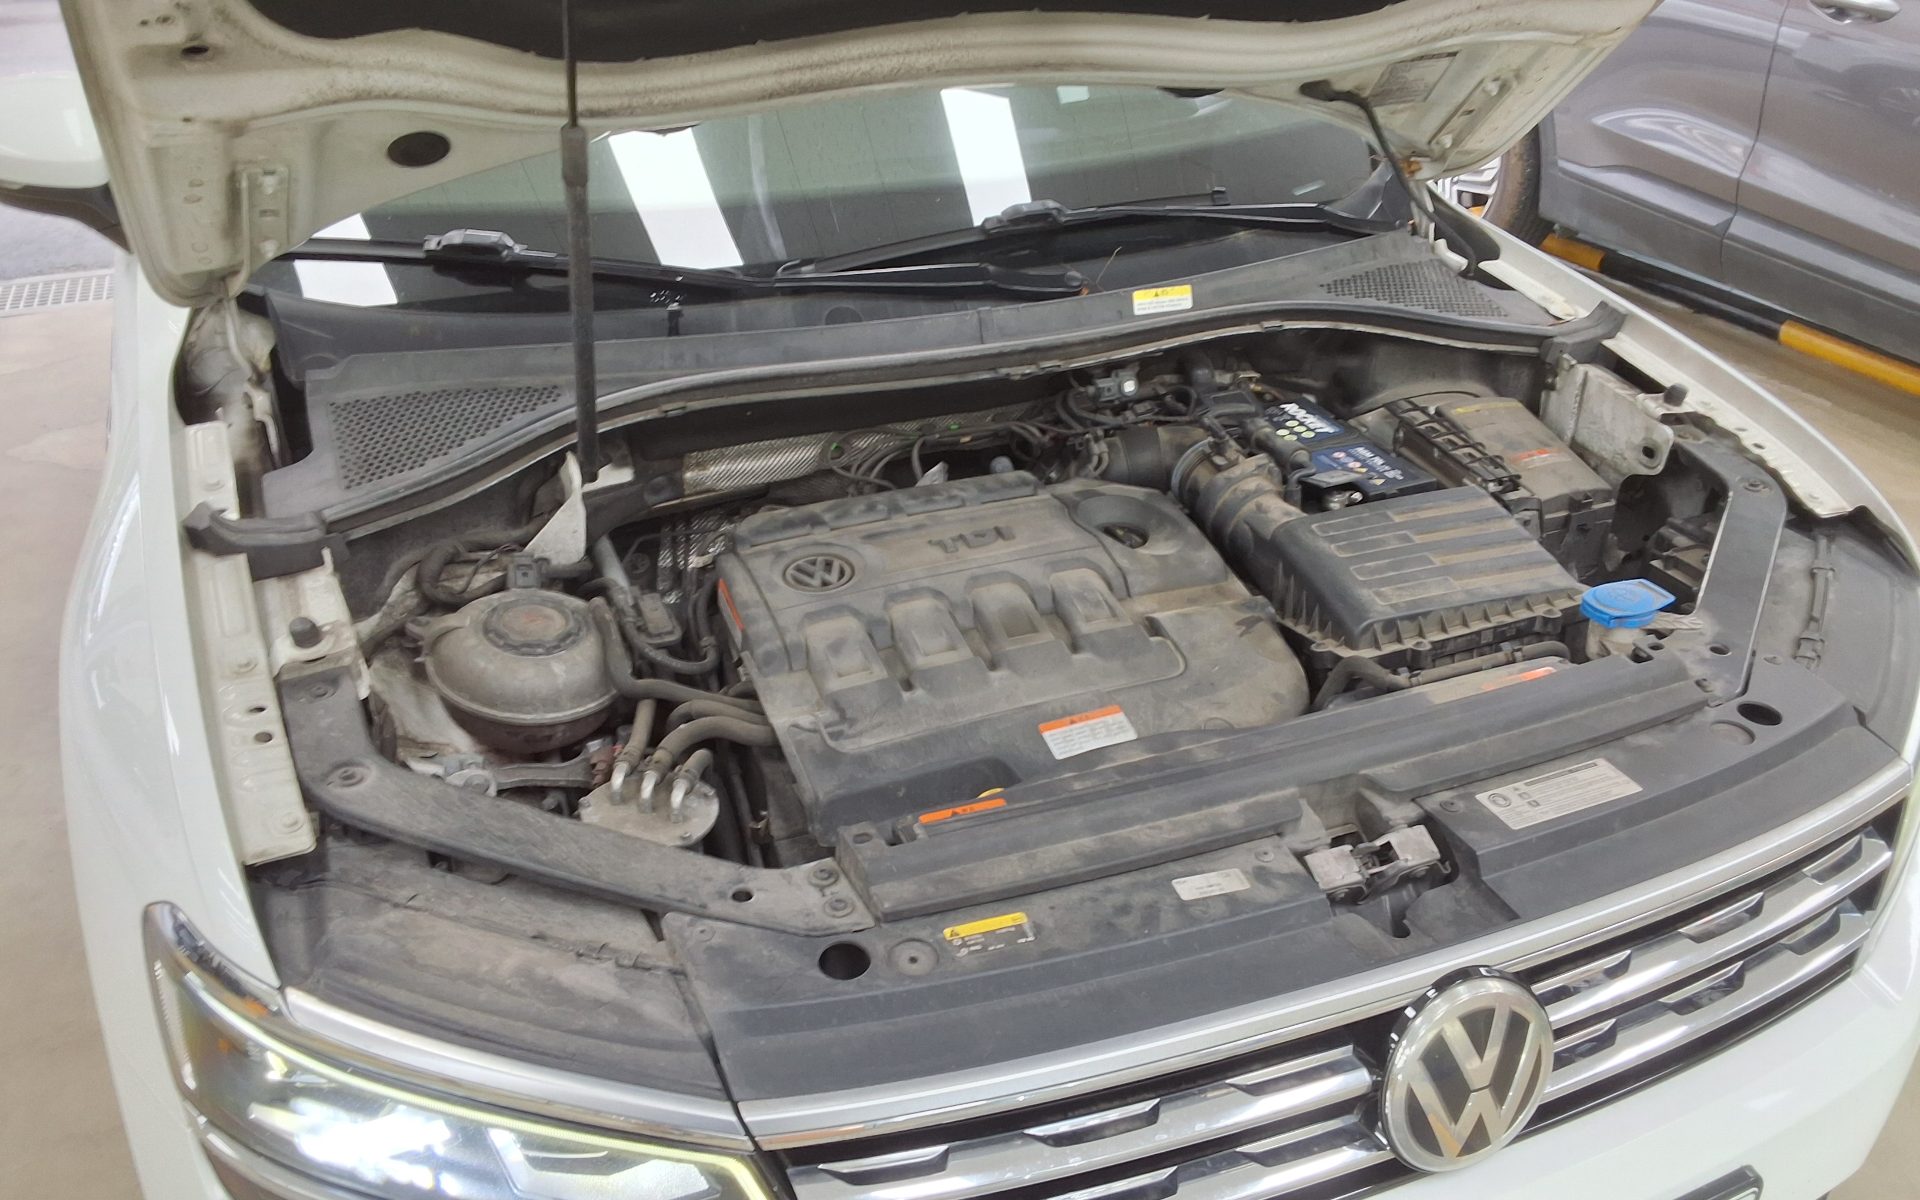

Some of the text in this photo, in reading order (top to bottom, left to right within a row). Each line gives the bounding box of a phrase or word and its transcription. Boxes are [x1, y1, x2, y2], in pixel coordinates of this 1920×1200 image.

[928, 526, 1016, 553] TDI
[785, 556, 850, 590] VW
[1393, 988, 1547, 1165] VW
